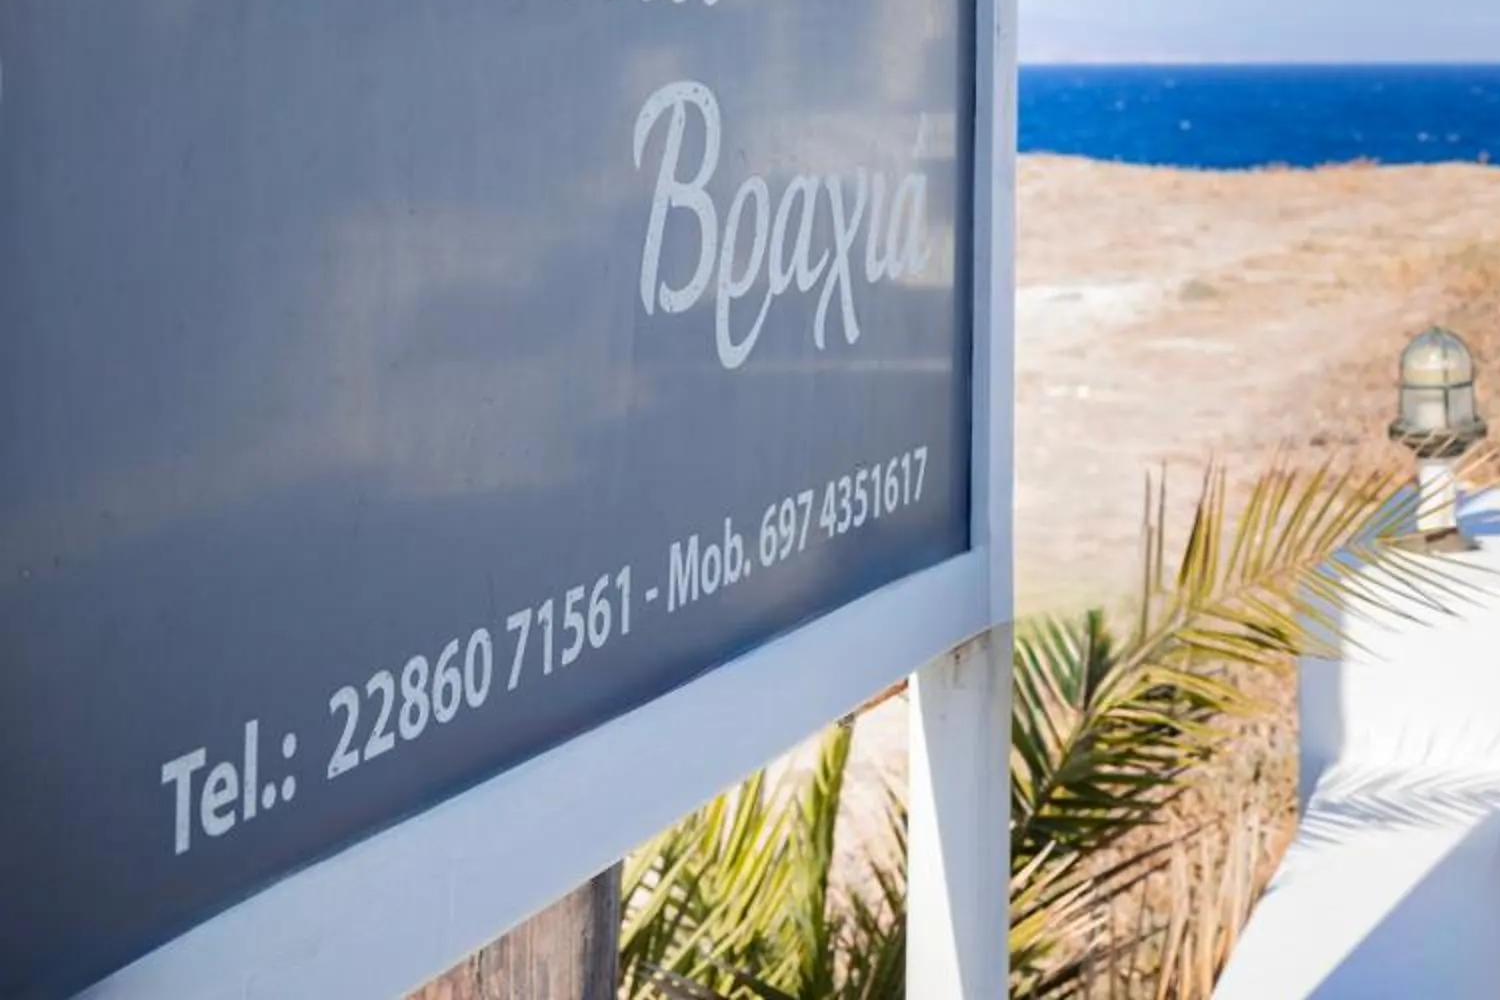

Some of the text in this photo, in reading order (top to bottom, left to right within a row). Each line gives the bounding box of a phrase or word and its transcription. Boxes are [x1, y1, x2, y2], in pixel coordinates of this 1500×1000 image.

[160, 719, 298, 856] Tel.:
[327, 627, 494, 780] 22860
[505, 564, 631, 692] 71561
[668, 517, 751, 613] Mob.
